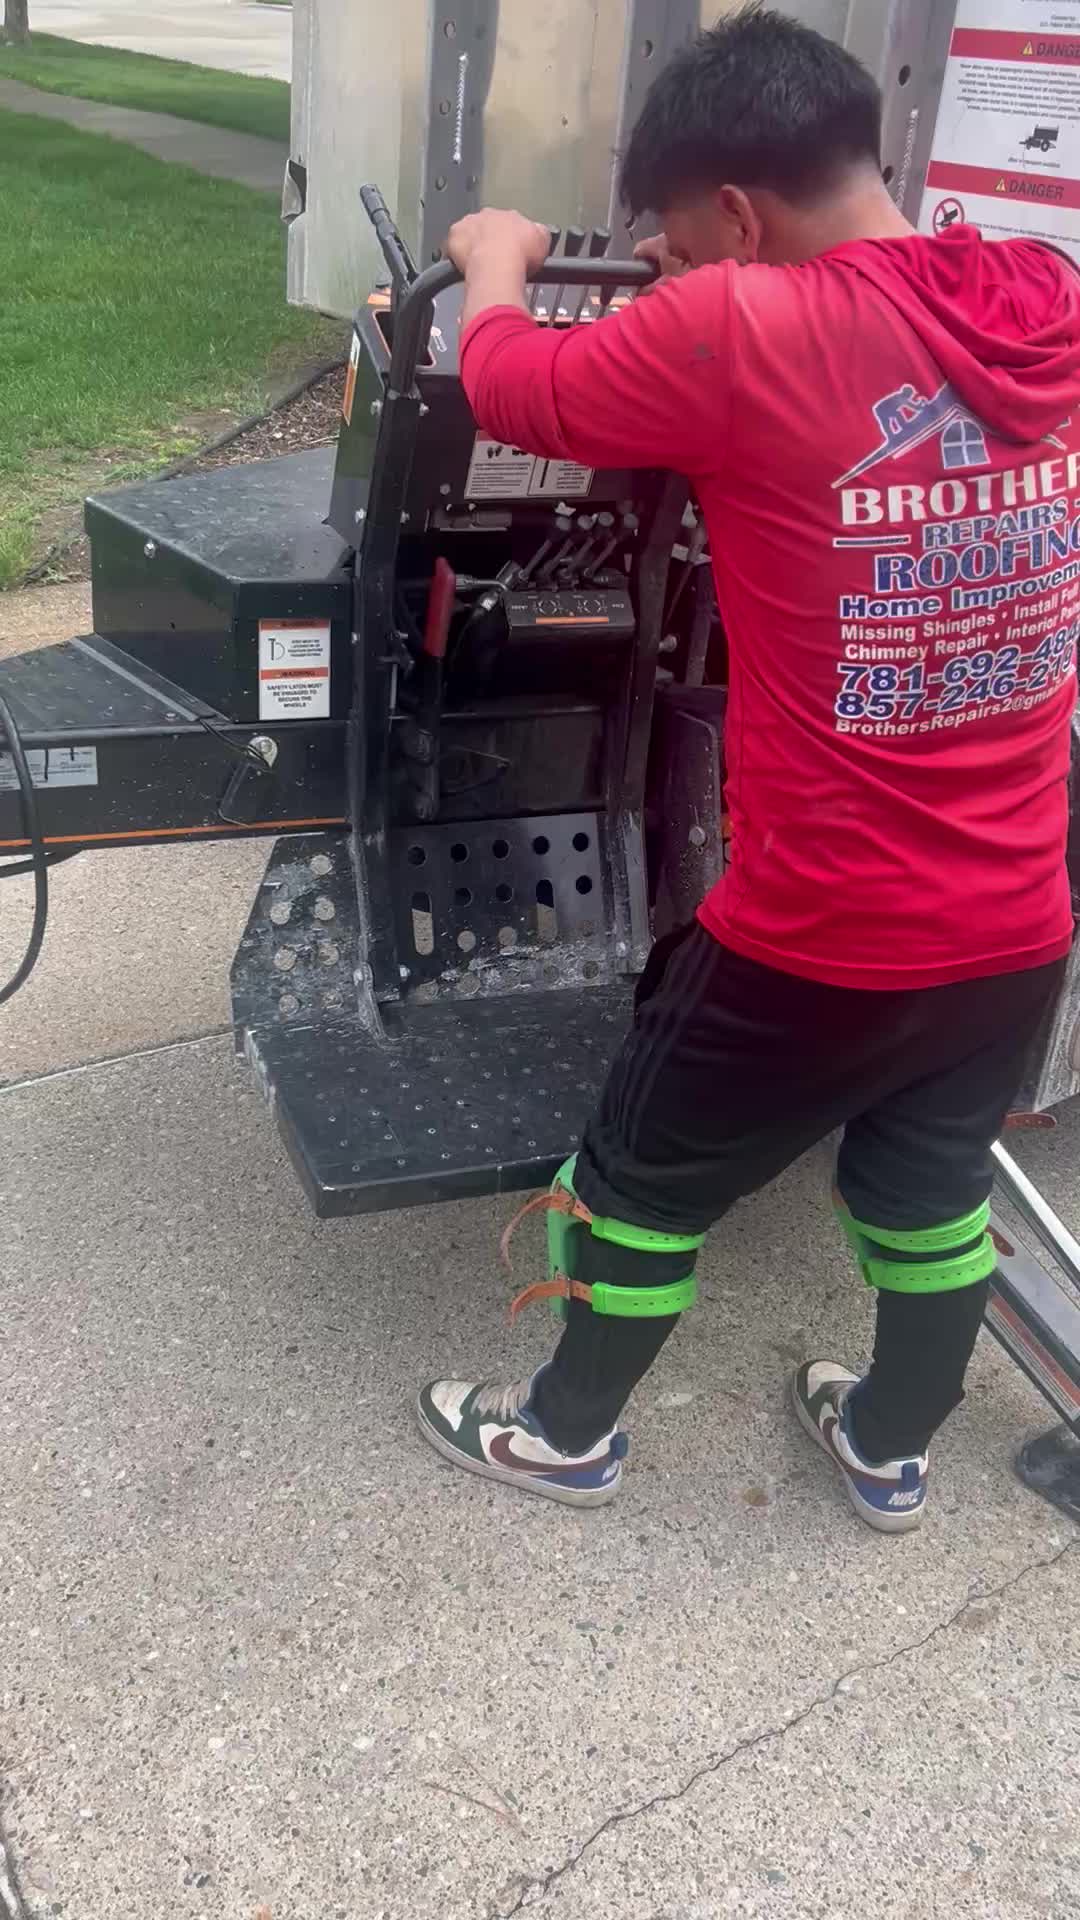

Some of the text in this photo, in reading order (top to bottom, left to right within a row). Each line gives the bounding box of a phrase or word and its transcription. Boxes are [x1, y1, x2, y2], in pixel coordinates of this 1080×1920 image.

[1008, 180, 1064, 200] DANGER
[922, 497, 1069, 549] REPAIRS
[840, 560, 1080, 619] Home Improvem
[841, 624, 917, 642] Missing
[923, 613, 996, 639] Shingles
[1014, 592, 1060, 621] Install
[845, 643, 929, 661] Chimney
[934, 633, 989, 656] Repair
[1006, 614, 1059, 641] Interior
